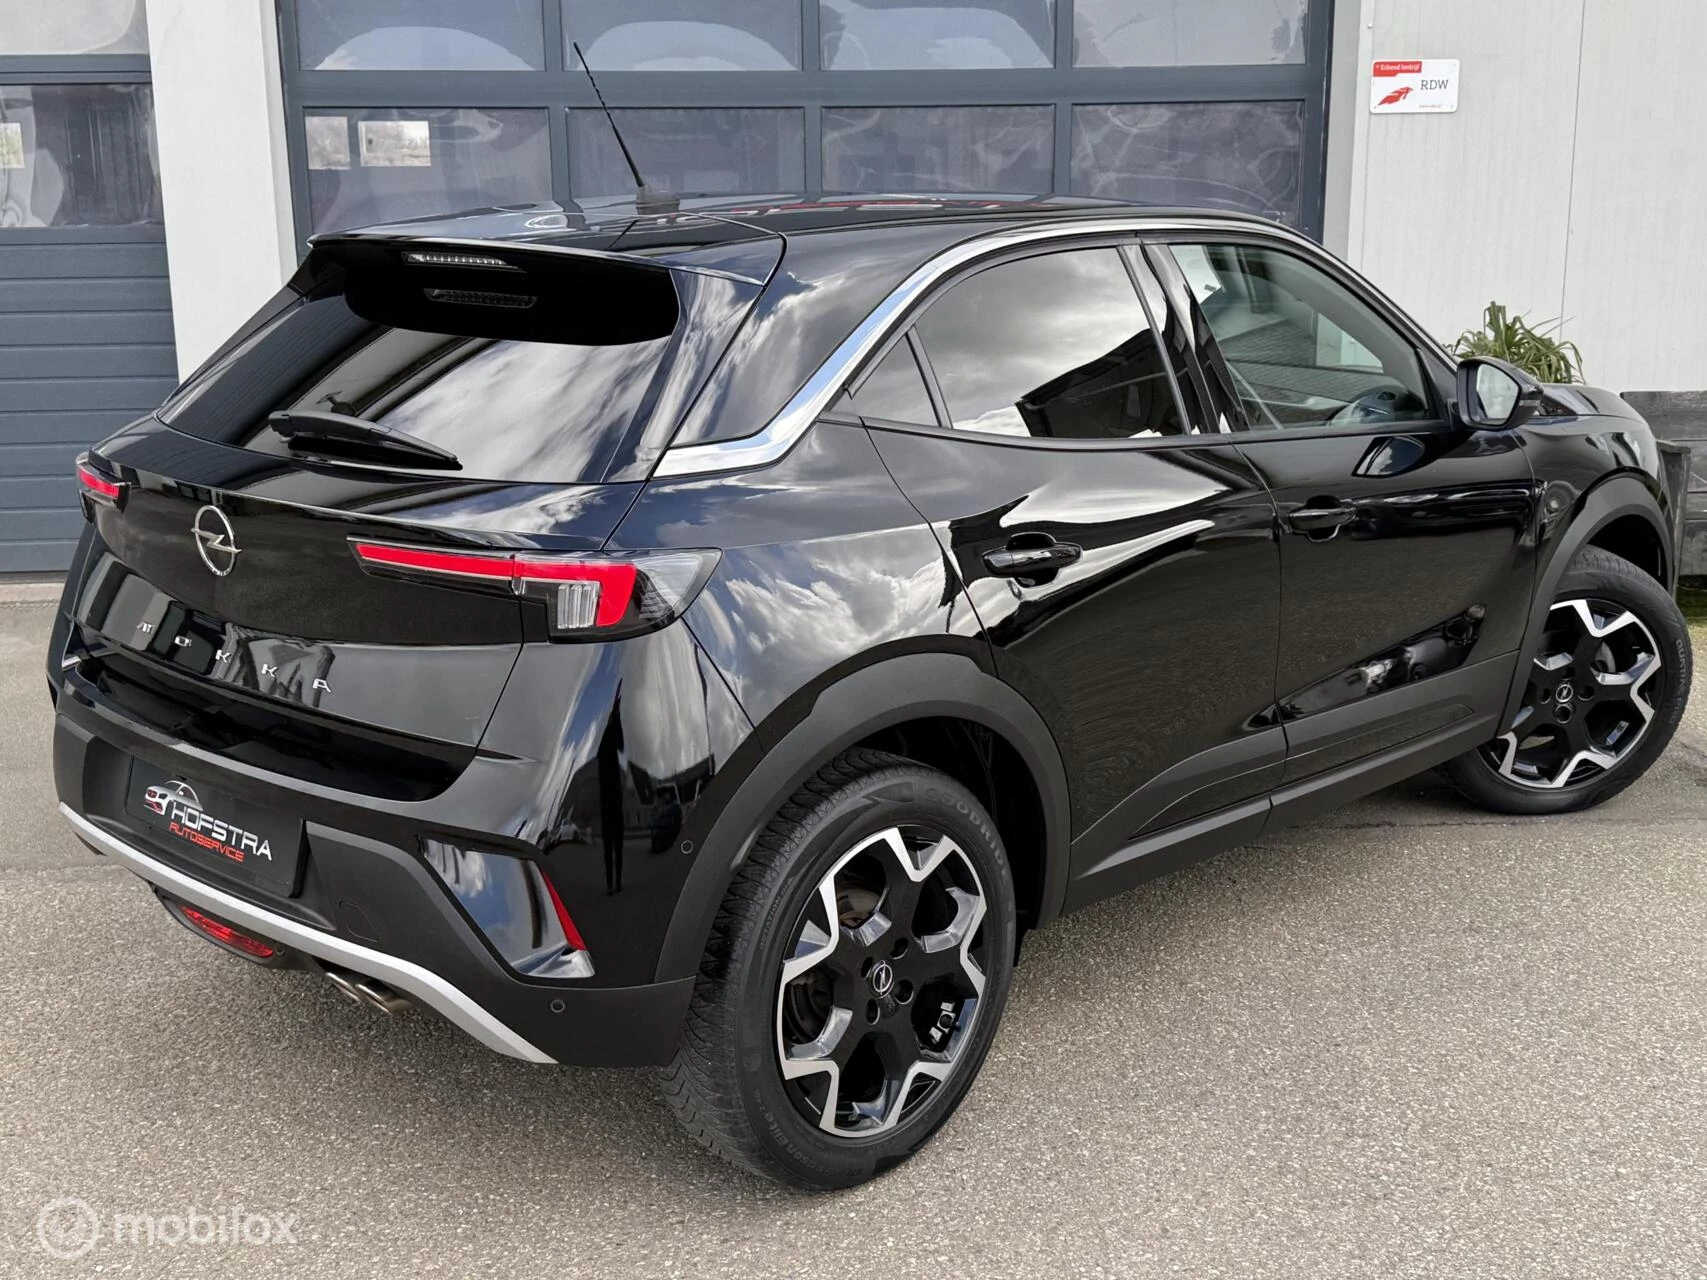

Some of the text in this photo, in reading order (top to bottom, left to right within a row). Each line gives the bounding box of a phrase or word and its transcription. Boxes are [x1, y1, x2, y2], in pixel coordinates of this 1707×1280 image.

[1420, 79, 1449, 90] RDW
[168, 822, 246, 863] AUTOSERVICE
[170, 801, 273, 861] HOFSTRA
